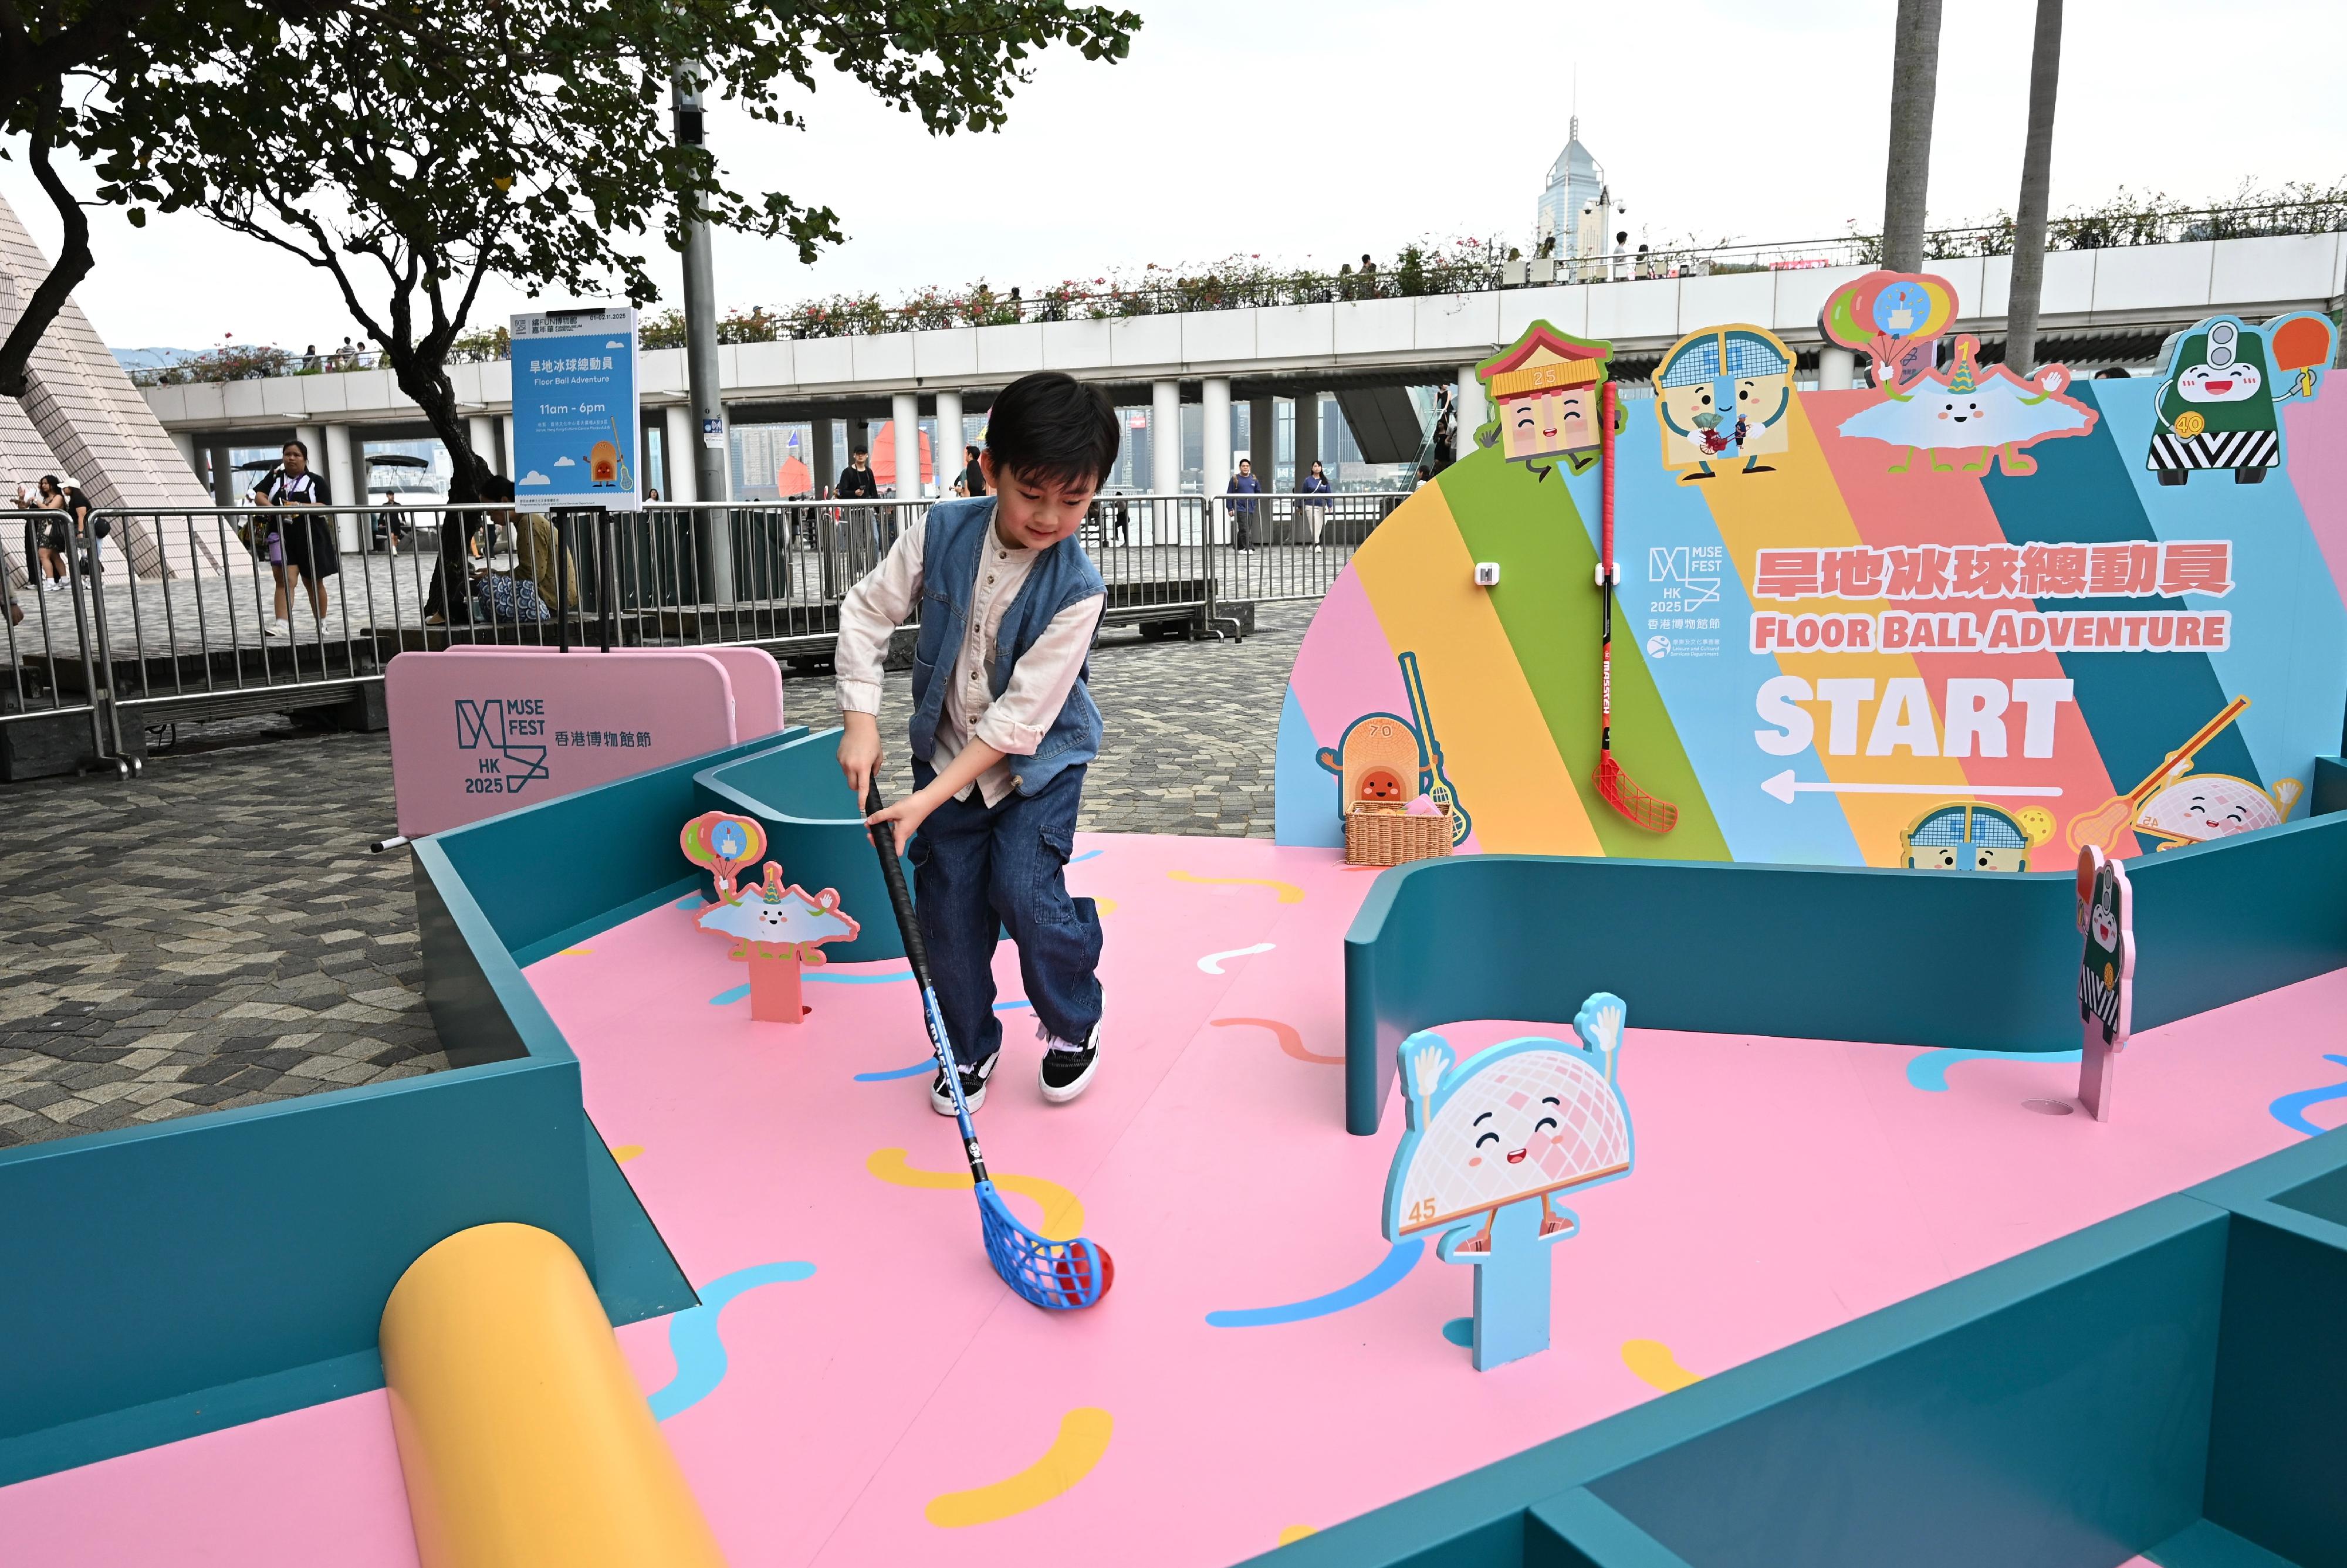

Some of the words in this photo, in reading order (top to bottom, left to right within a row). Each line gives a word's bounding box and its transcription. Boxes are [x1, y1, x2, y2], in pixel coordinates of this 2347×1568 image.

[530, 357, 614, 374] 旱地冰球總動員
[571, 375, 610, 384] Adventure
[1533, 370, 1557, 386] 25
[540, 404, 568, 414] 11am
[579, 402, 605, 415] 6pm
[2176, 418, 2203, 432] 40
[1692, 546, 1723, 557] MUSE
[1692, 560, 1723, 571] FEST
[1757, 541, 2234, 598] 旱地冰球總動員
[1663, 588, 1681, 599] HK
[1651, 602, 1682, 612] 2025
[1648, 618, 1720, 629] 香港博物館節
[1755, 615, 1871, 649] FLOOR
[1882, 615, 1977, 649] BALL
[1987, 612, 2226, 648] ADVENTURE
[508, 699, 545, 714] MUSE
[1754, 675, 2074, 758] START
[509, 720, 545, 736] FEST
[1370, 725, 1391, 737] 70
[555, 731, 651, 748] 香港博物館節
[478, 758, 500, 773] HK
[465, 778, 503, 793] 2025
[1408, 1197, 1436, 1222] 45
